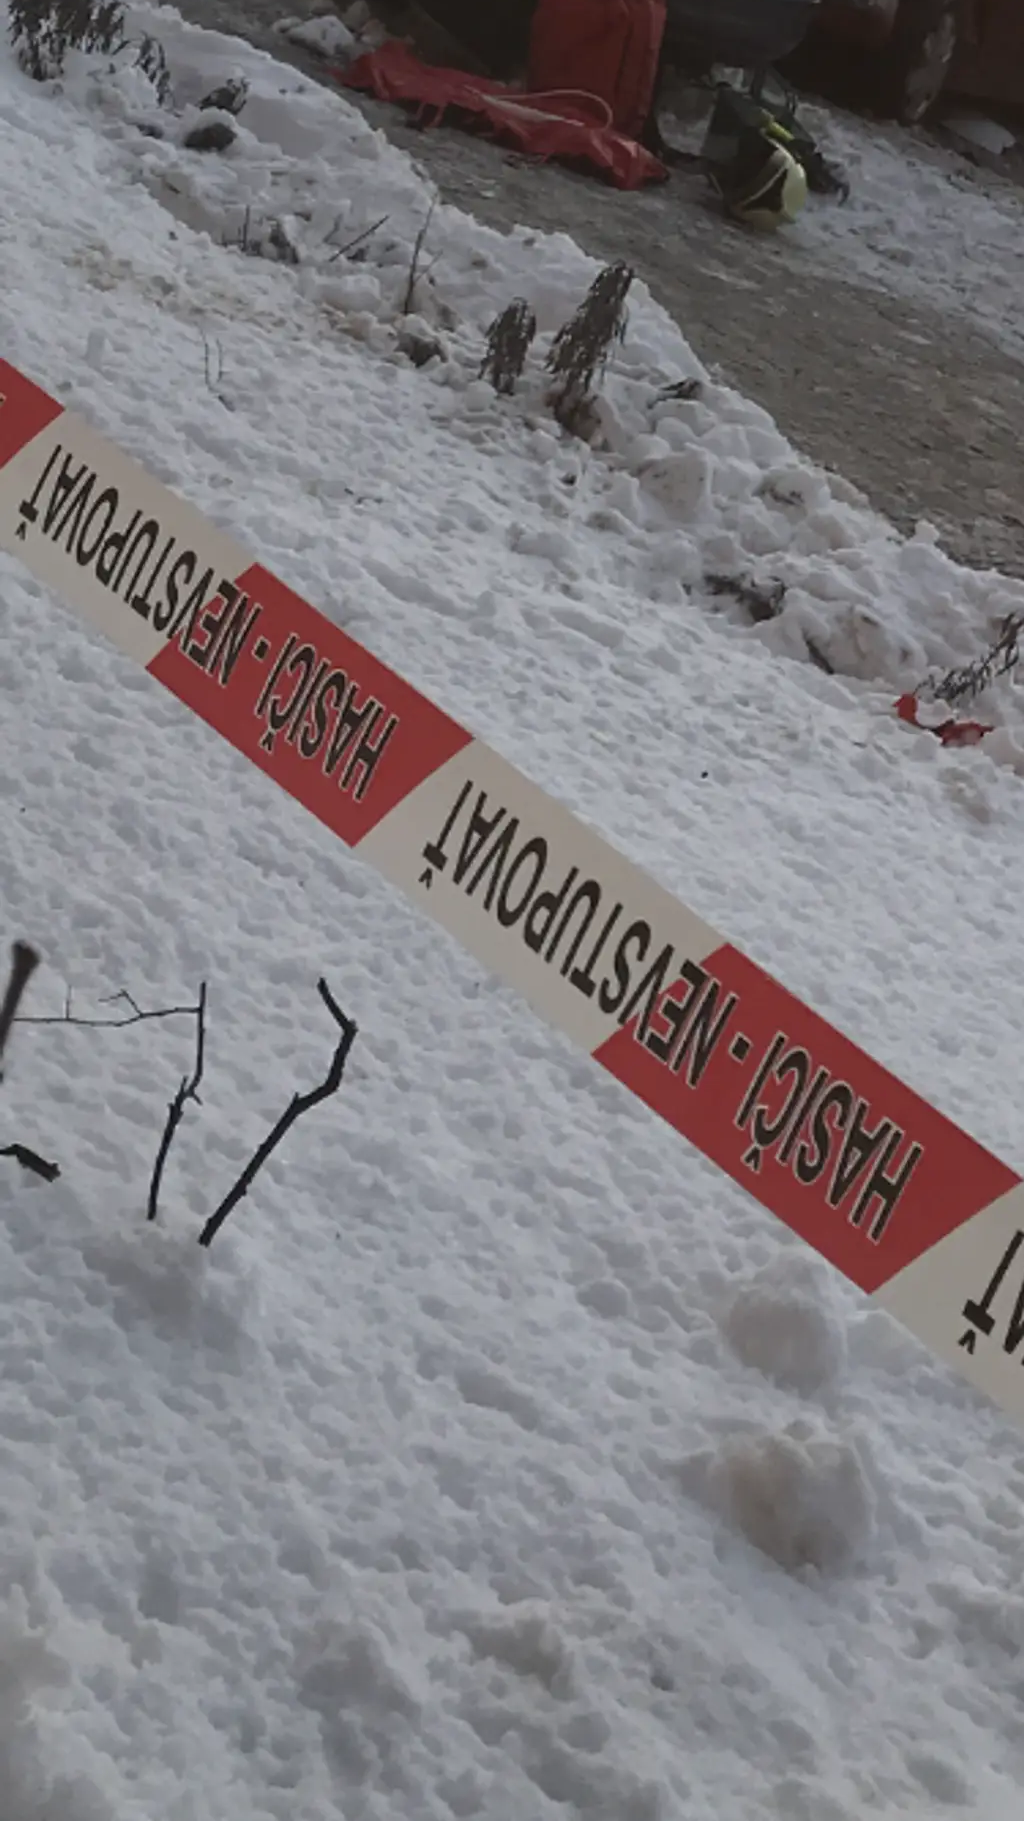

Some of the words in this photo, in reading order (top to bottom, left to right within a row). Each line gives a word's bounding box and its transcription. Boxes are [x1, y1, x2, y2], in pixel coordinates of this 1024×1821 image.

[16, 445, 264, 685] NEVSTUPOVAŤ
[256, 633, 399, 802] HASIČI
[417, 781, 739, 1088] NEVSTUPOVAŤ
[734, 1032, 924, 1244] HASIČI
